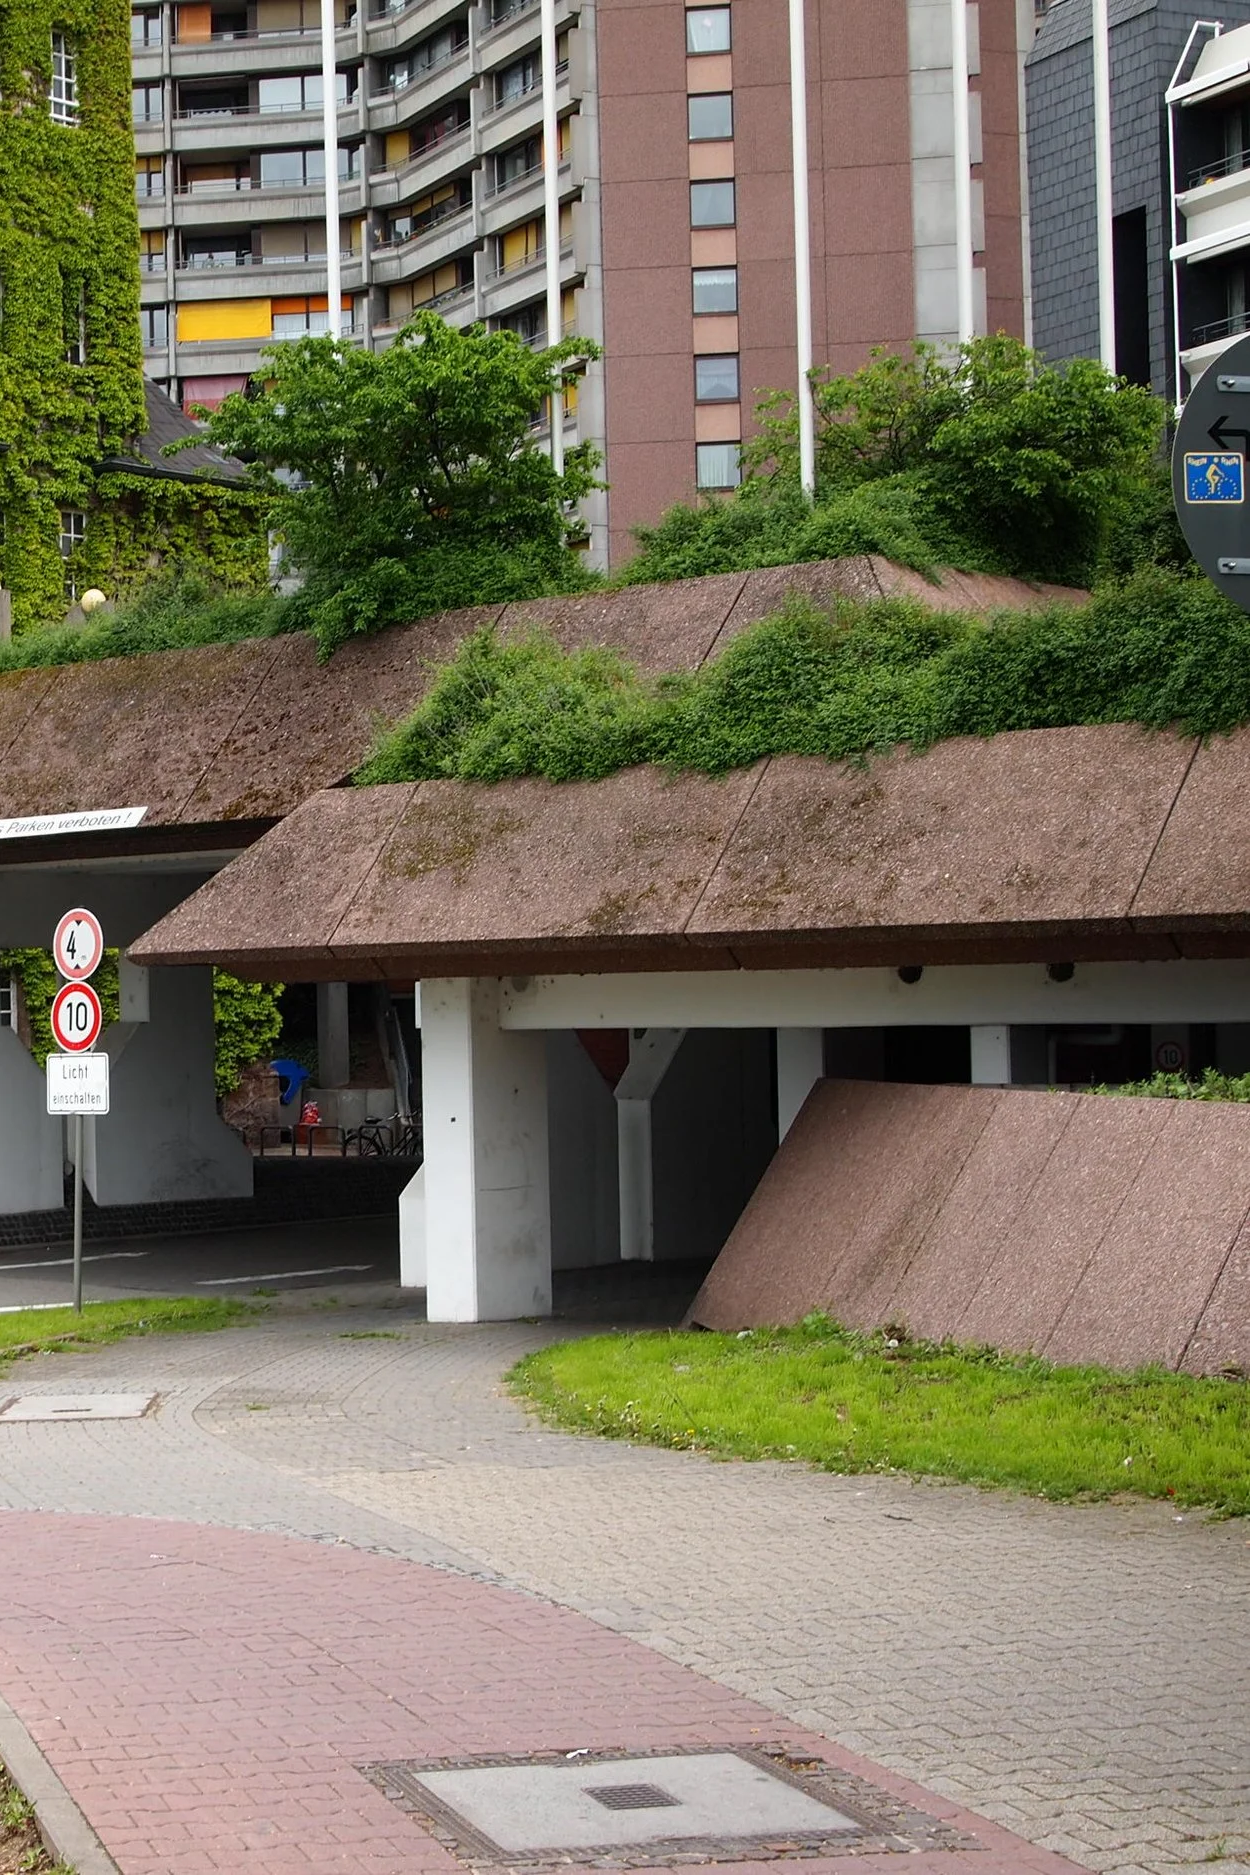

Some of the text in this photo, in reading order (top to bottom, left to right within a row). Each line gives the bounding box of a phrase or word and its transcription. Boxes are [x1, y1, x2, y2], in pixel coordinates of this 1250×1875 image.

[6, 821, 54, 834] Parken
[58, 814, 121, 829] verboten
[66, 930, 77, 960] 4
[66, 1002, 88, 1031] 10
[62, 1064, 88, 1079] Licht
[53, 1092, 101, 1104] einschalten
